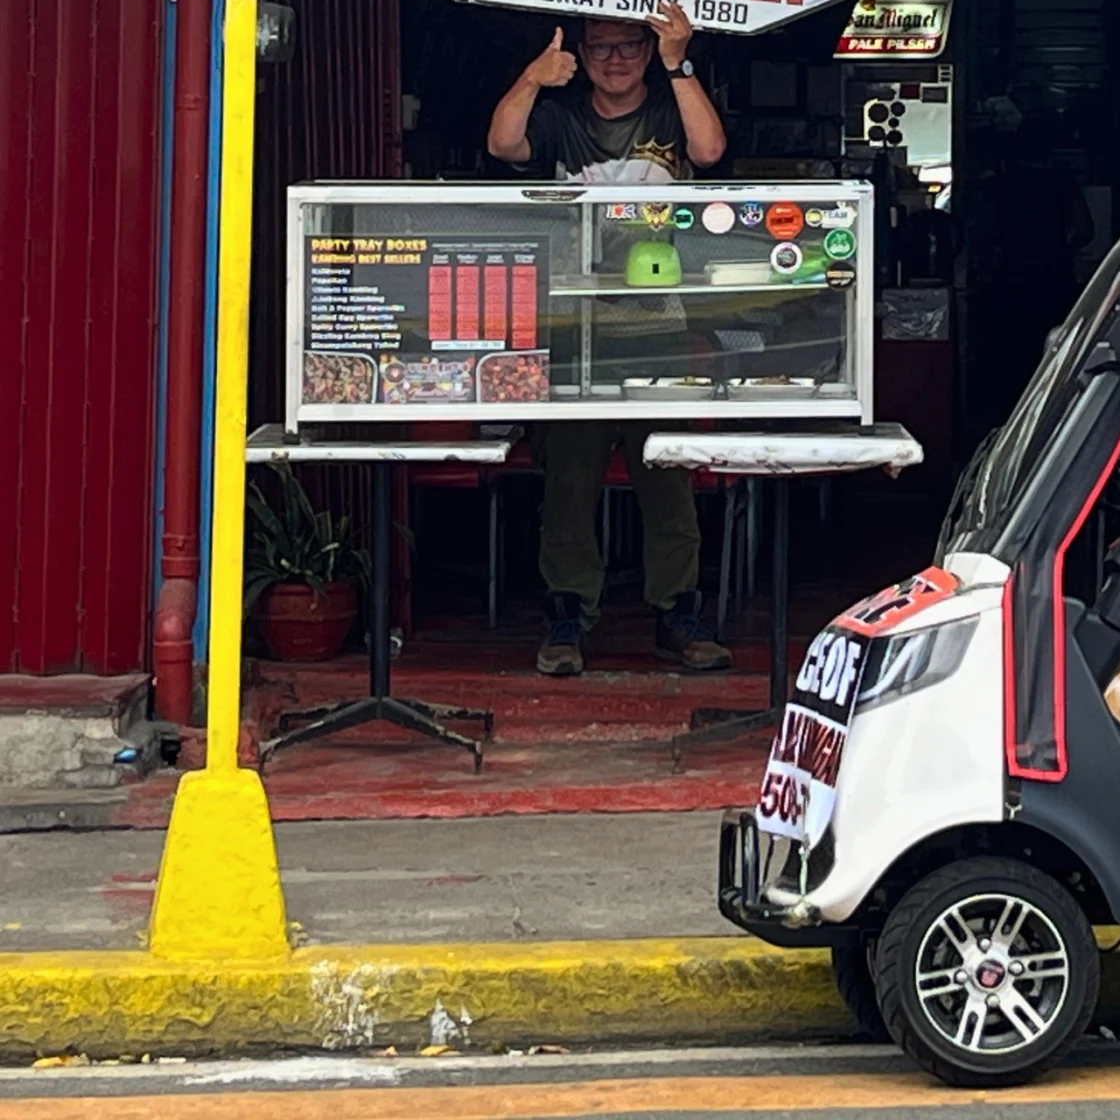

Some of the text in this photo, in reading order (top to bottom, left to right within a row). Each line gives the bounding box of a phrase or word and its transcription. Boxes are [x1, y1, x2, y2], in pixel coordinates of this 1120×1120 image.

[875, 7, 938, 32] Miguel
[848, 38, 936, 50] PALE PILSEN
[353, 238, 384, 251] TRAY
[387, 238, 427, 251] BOXES
